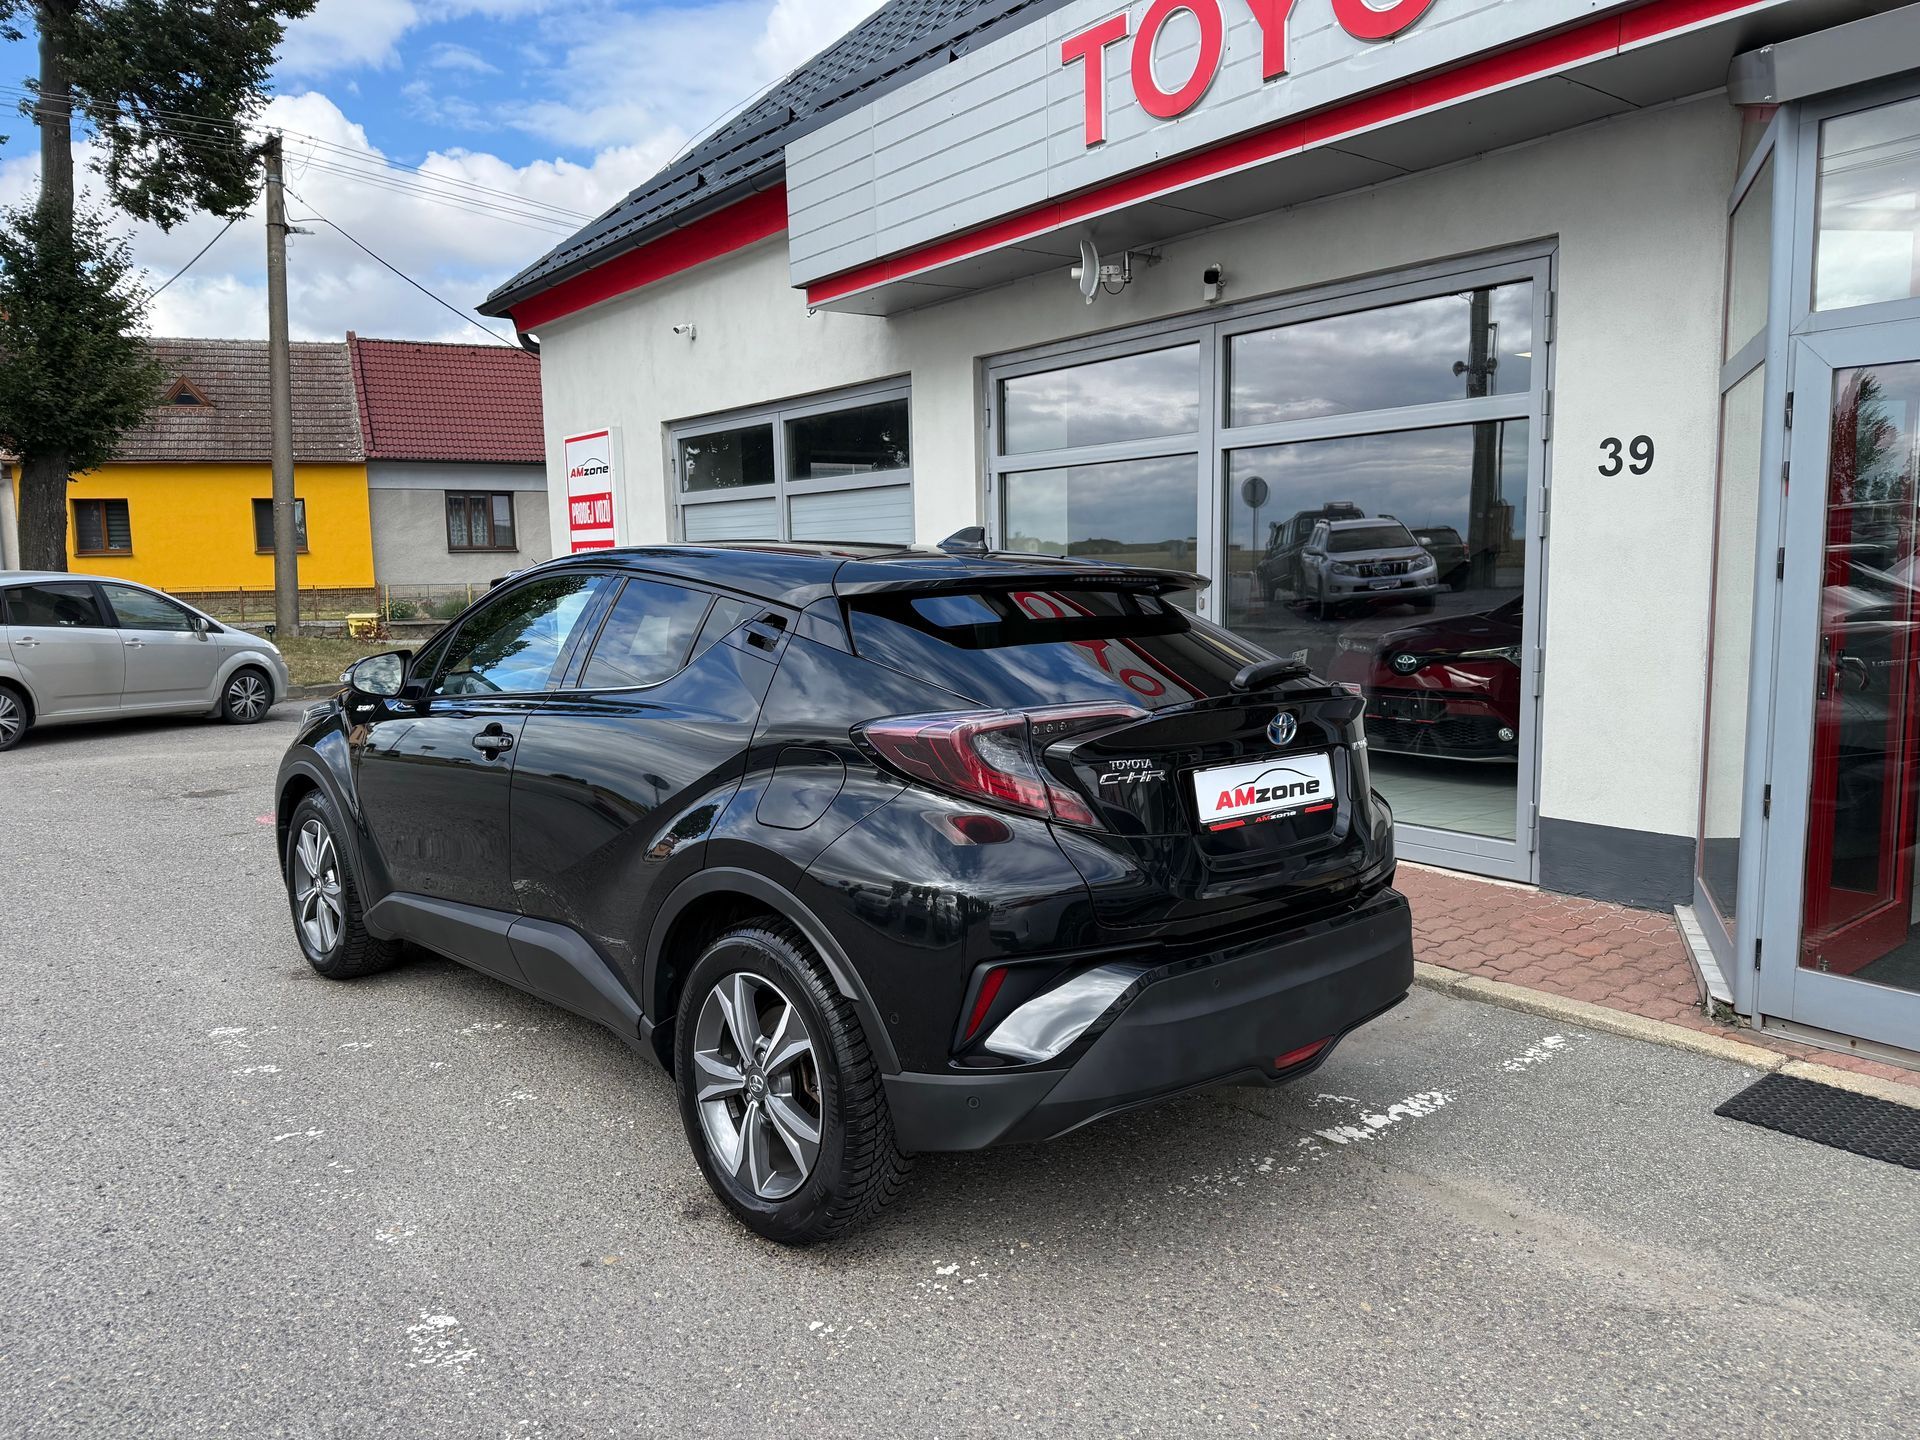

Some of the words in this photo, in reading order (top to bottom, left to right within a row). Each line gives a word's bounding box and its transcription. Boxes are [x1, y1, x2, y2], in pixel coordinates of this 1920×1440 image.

[1598, 434, 1655, 477] 39
[570, 465, 609, 478] AMzone
[571, 501, 594, 525] PRODEJ
[1109, 759, 1153, 770] TOYOTA
[1100, 770, 1166, 785] C-HR
[1215, 779, 1320, 811] AMzone
[1255, 810, 1297, 823] AMzone
